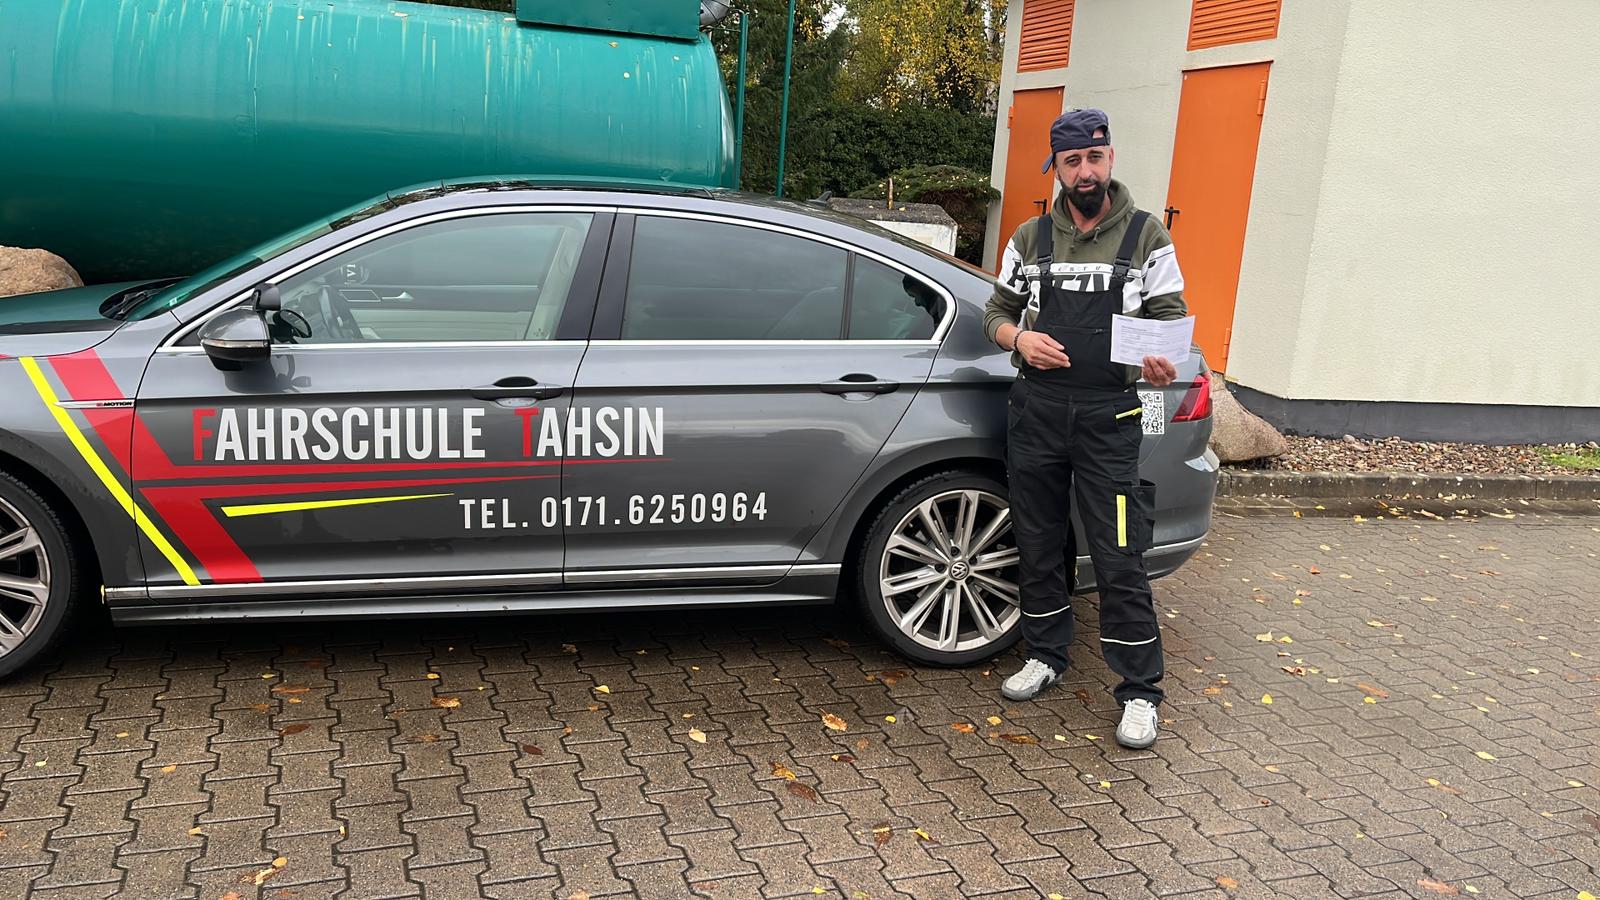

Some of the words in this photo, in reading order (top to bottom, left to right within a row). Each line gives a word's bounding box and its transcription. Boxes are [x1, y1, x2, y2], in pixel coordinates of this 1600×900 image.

[192, 407, 486, 461] FAHRSCHULE
[514, 406, 664, 457] TAHSIN
[459, 498, 528, 529] TEL.
[541, 492, 768, 528] 0171.6250964
